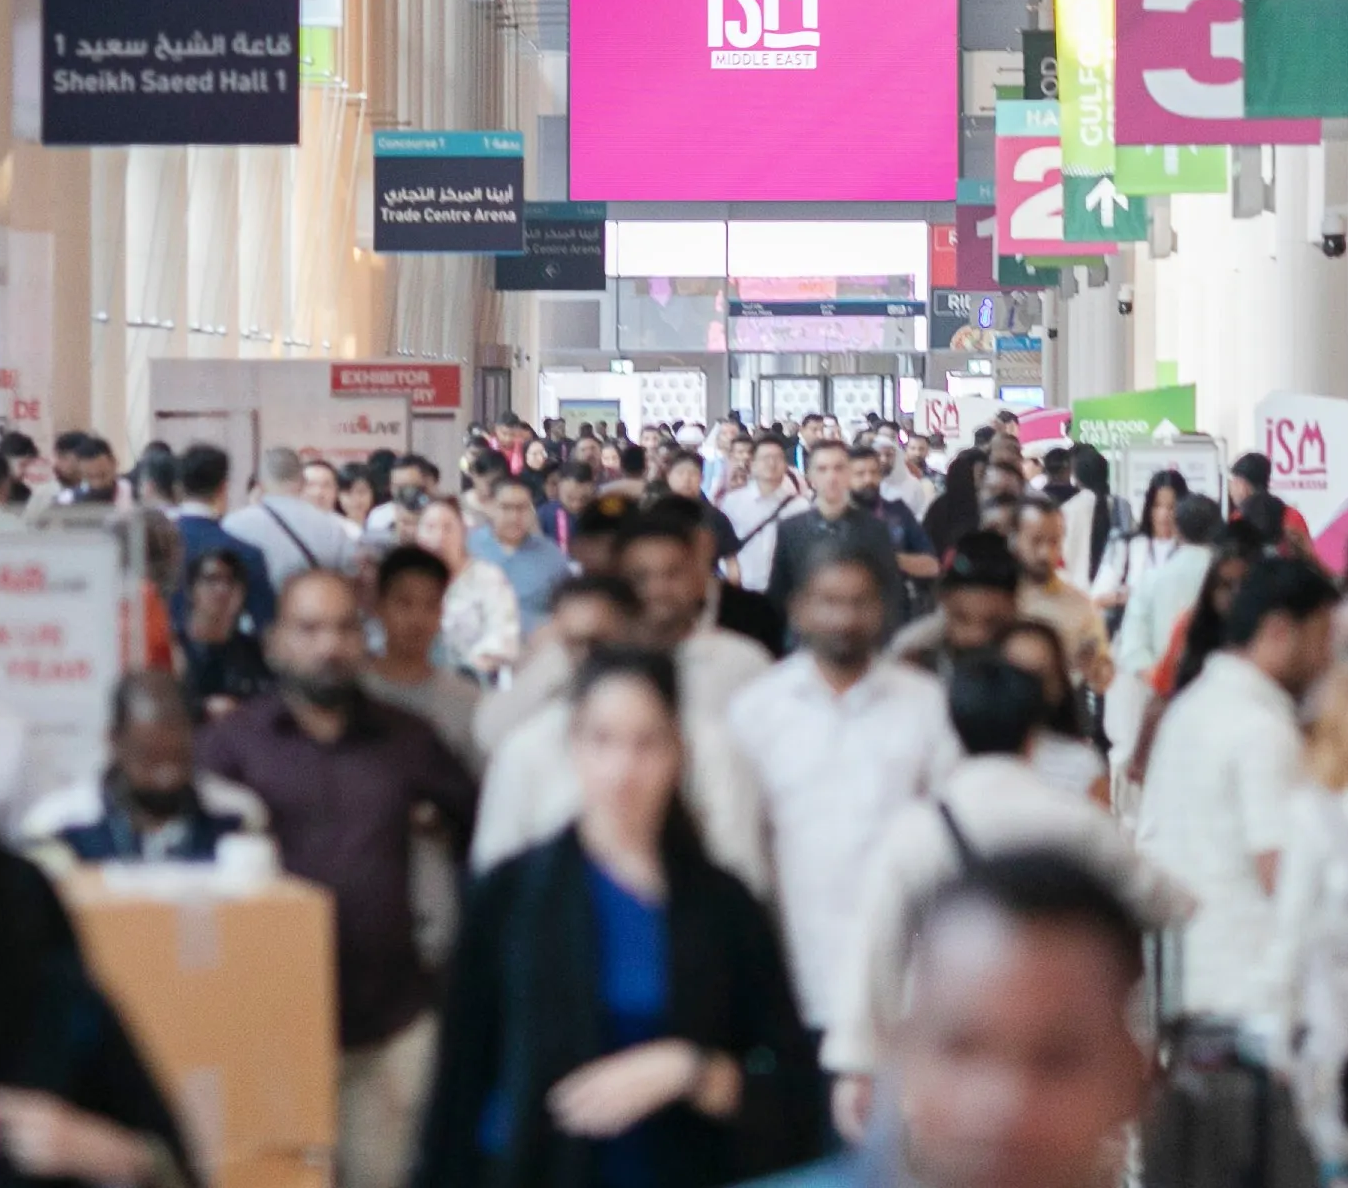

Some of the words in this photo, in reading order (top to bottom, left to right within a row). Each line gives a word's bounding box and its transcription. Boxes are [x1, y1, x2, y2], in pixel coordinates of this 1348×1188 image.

[54, 33, 66, 57] 1
[75, 37, 149, 62] سعيد
[154, 30, 226, 61] الشيخ
[232, 32, 292, 57] قاعة
[715, 52, 769, 66] MIDDLE
[776, 52, 812, 66] EAST
[53, 68, 136, 93] Sheikh
[140, 69, 215, 93] Saeed
[219, 69, 270, 93] Hall
[274, 69, 287, 93] 1
[1025, 109, 1059, 128] HA
[378, 137, 437, 150] Concourse
[439, 137, 446, 149] 1
[383, 186, 436, 207] التجاري
[438, 187, 483, 204] المركز
[380, 207, 422, 223] Trade
[423, 207, 471, 223] Centre
[473, 207, 517, 223] Arena
[570, 243, 602, 255] Arena
[340, 369, 430, 386] EXHIBITOR
[1079, 419, 1149, 434] GULFOOD
